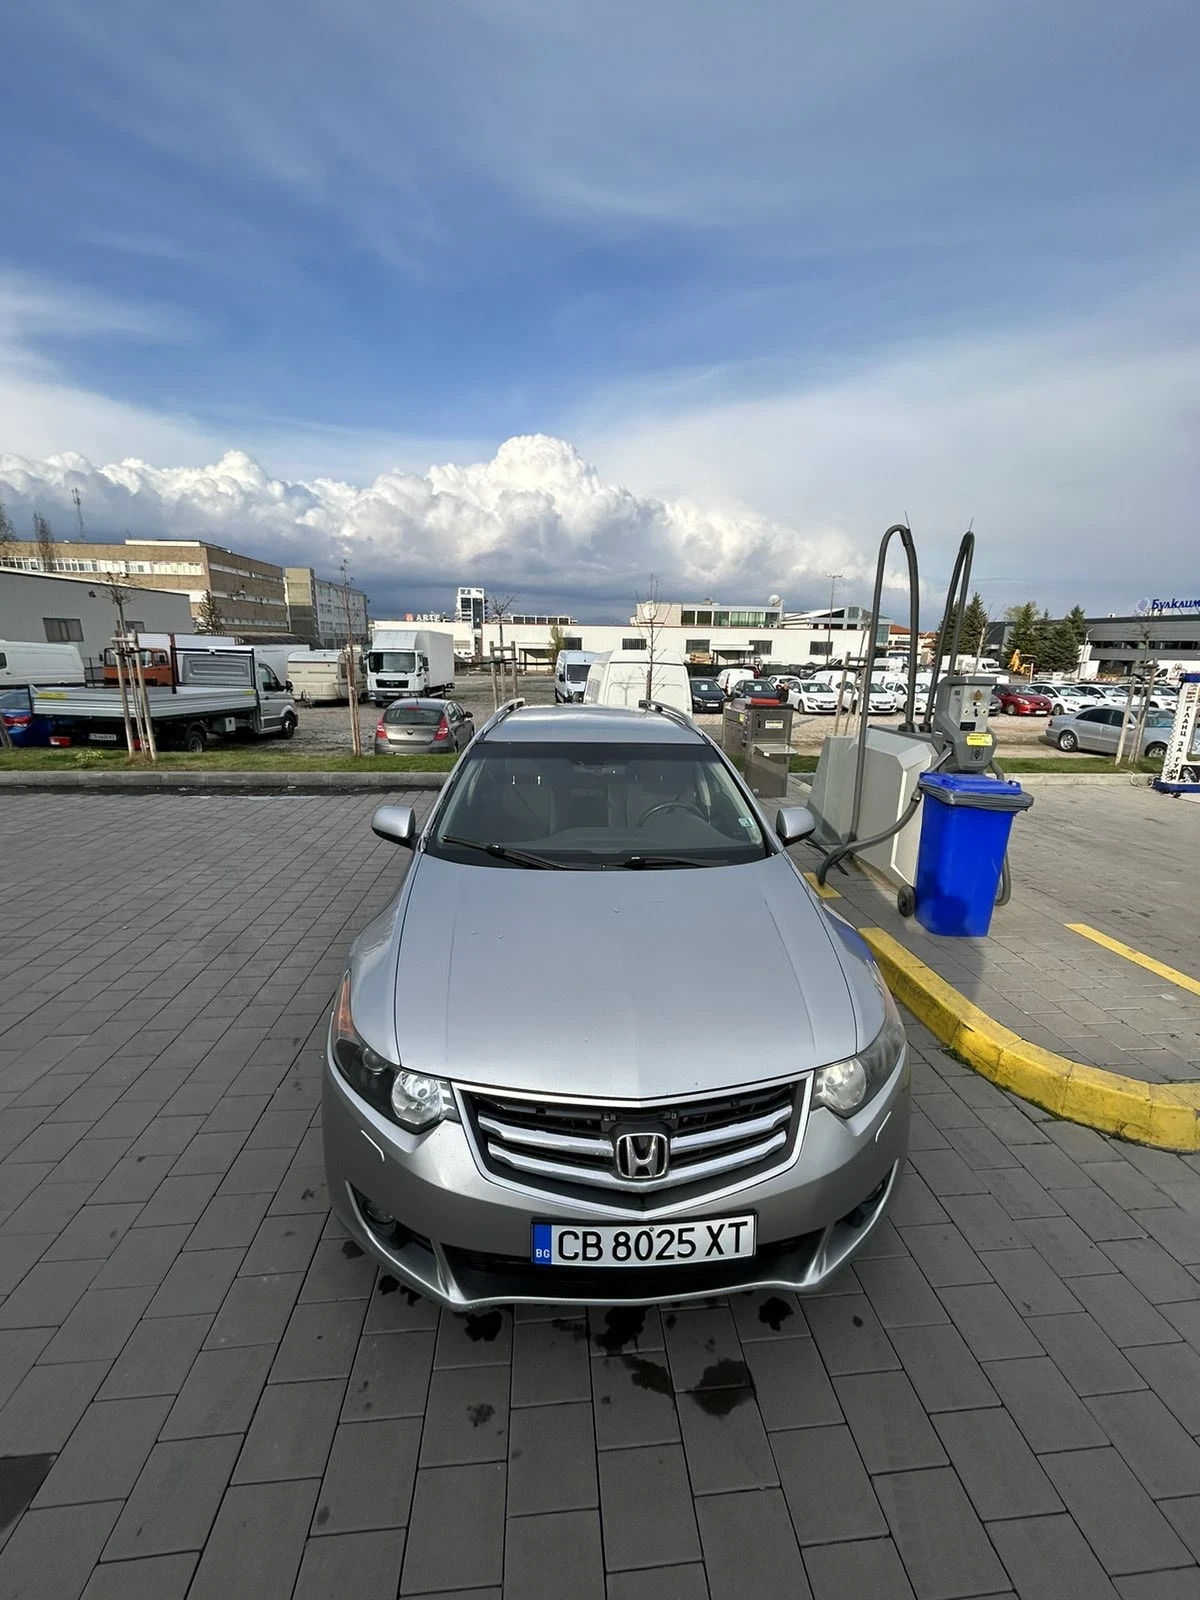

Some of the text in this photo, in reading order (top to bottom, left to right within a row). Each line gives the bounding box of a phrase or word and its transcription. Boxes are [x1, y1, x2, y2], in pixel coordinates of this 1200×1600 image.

[1180, 706, 1191, 736] ГЛАНЦ
[1176, 741, 1184, 752] ЗА
[536, 1221, 748, 1261] BG CB 8025 XT
